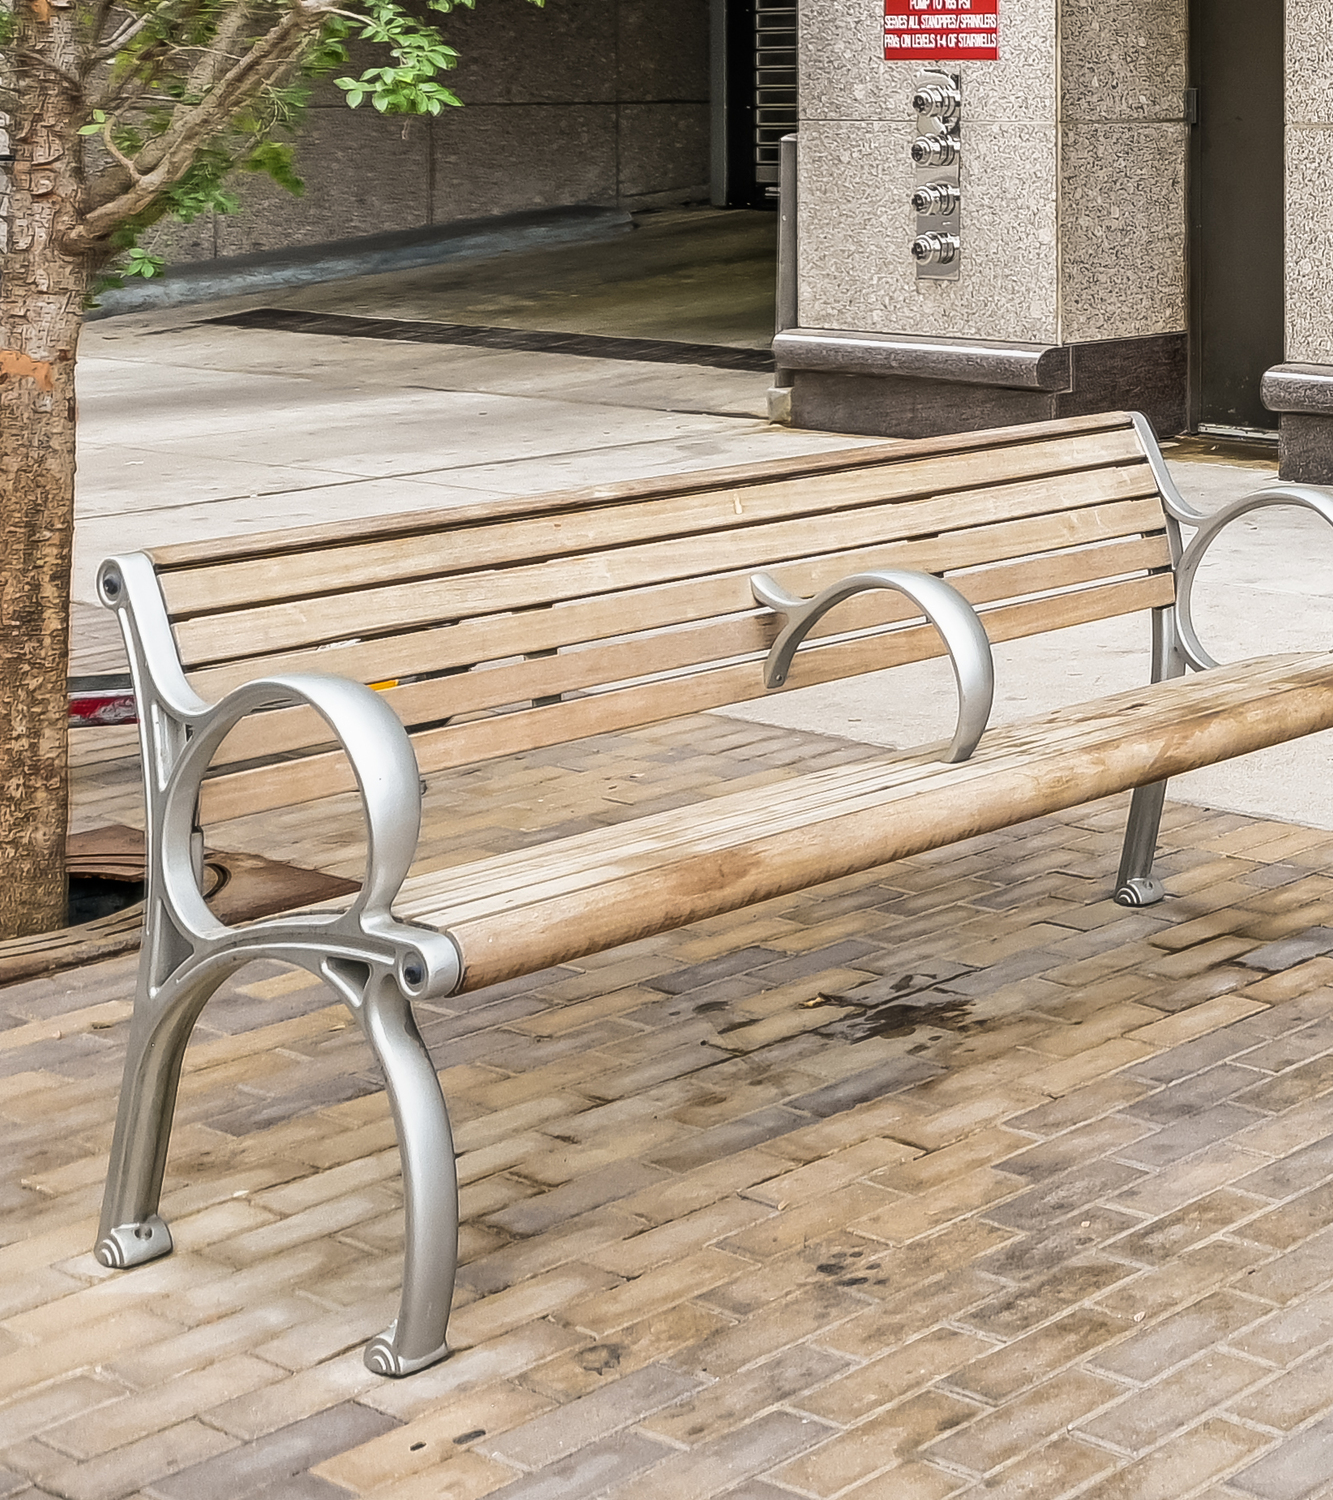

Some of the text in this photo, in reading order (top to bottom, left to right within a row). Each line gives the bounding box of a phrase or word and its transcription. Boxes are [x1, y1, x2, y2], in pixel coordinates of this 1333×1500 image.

[908, 15, 920, 29] ALL
[900, 33, 911, 48] ON
[912, 33, 936, 48] LEVELS
[947, 33, 957, 47] OF
[958, 33, 997, 48] STAIRWELLS
